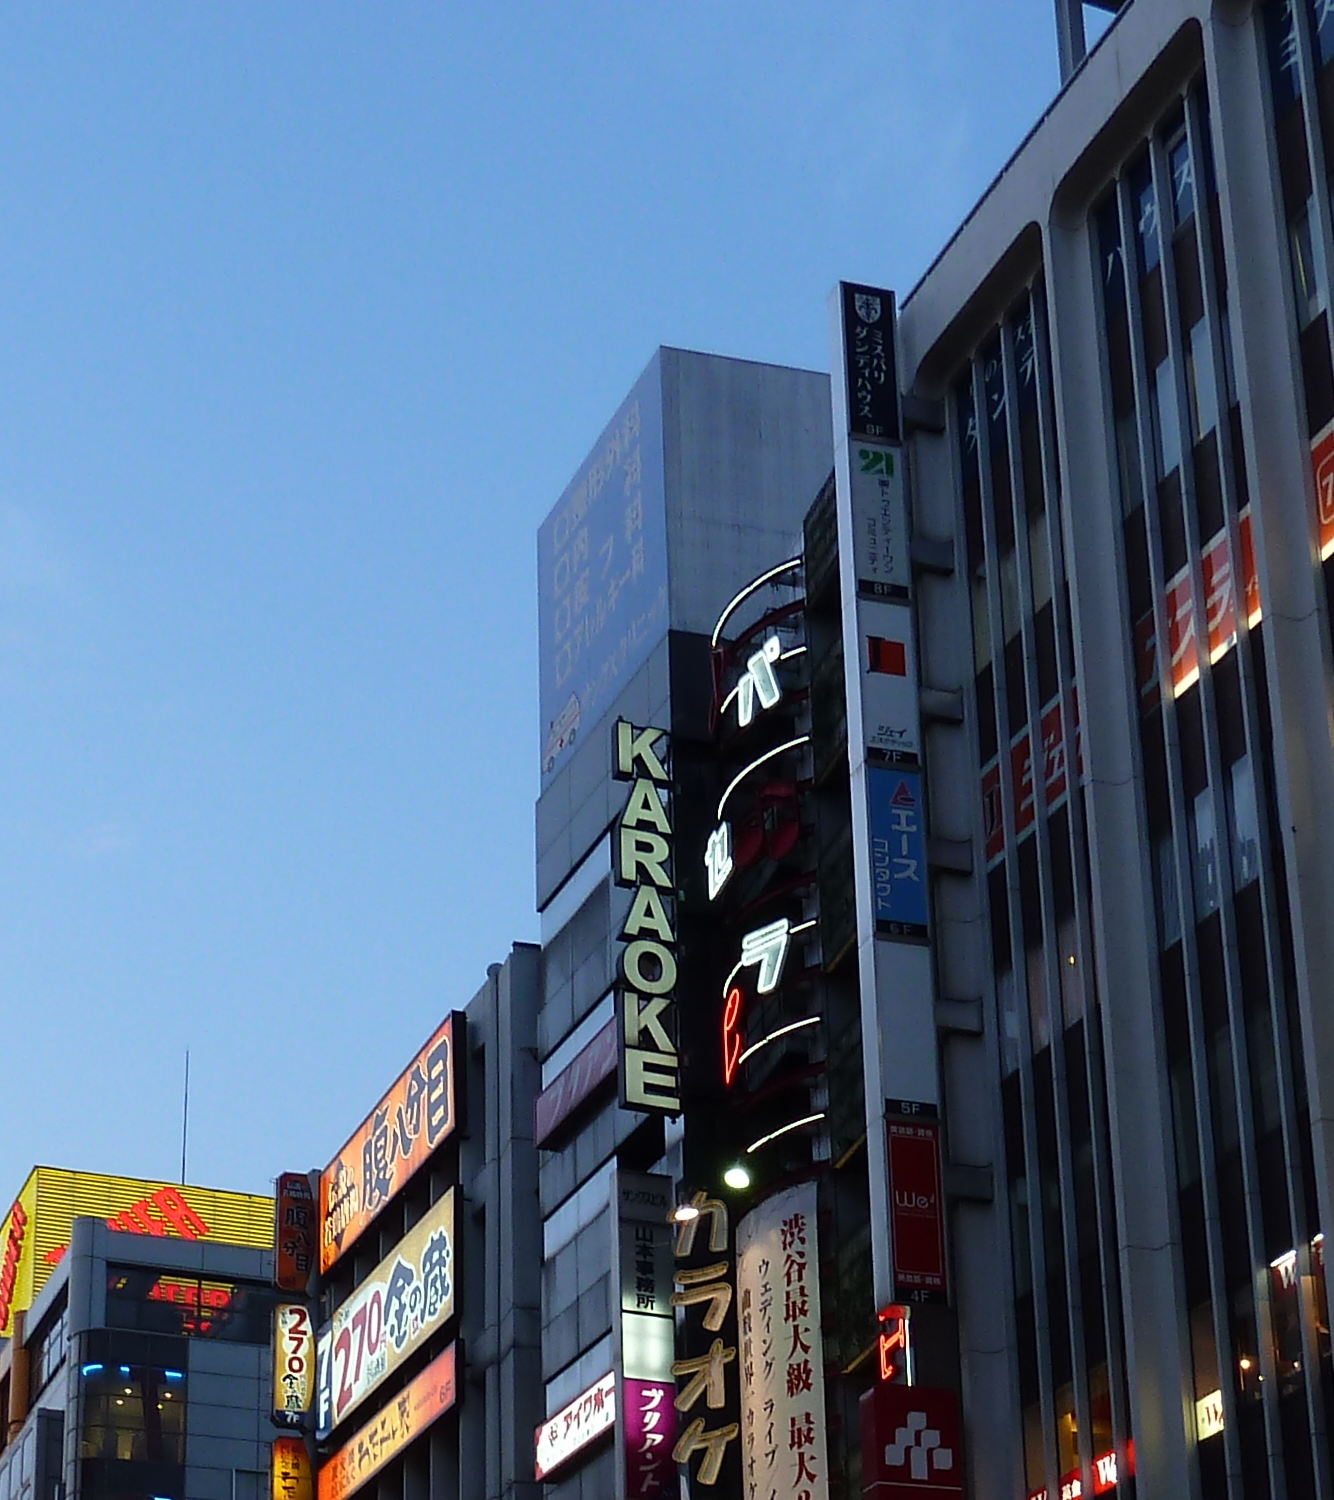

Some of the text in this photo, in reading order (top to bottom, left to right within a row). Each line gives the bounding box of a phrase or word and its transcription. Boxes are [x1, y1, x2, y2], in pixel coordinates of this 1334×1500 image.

[881, 749, 903, 763] 7F
[872, 837, 893, 911] コンタクト
[890, 808, 920, 883] エース
[617, 720, 681, 1114] KARAOKE
[900, 1102, 921, 1115] 5F
[634, 1226, 656, 1311] 山本事務所
[909, 1289, 930, 1302] 4F
[287, 1307, 308, 1374] 270
[284, 1410, 301, 1423] 7F
[638, 1387, 666, 1492] ブリアント
